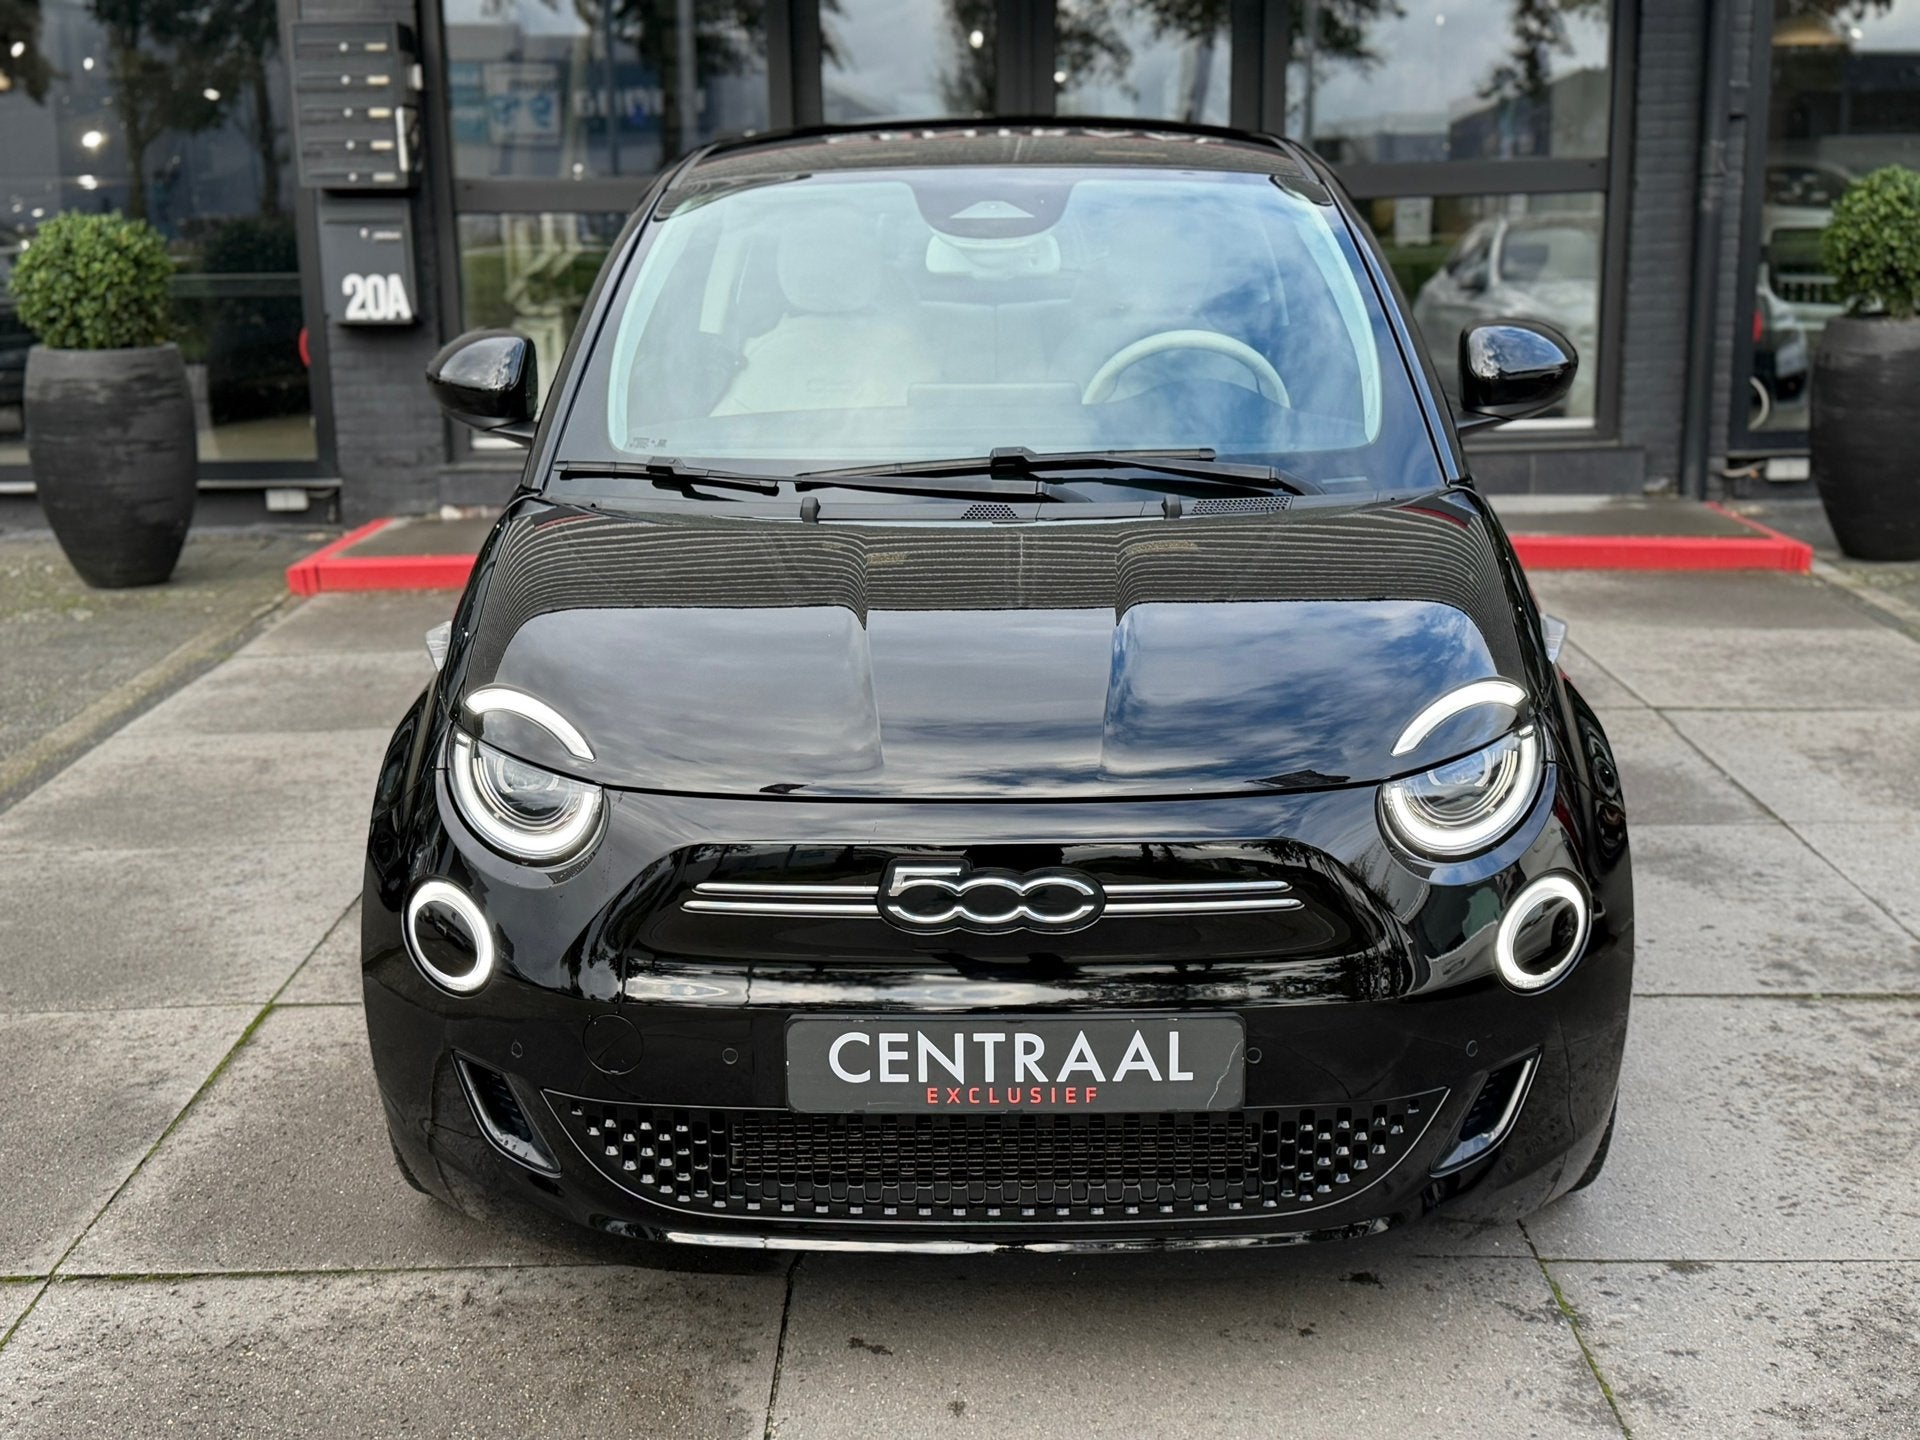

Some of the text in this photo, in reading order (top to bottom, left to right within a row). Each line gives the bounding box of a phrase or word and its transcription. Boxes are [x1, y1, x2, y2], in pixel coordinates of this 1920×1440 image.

[341, 273, 412, 321] 20A
[887, 866, 1097, 925] 500
[828, 1030, 1194, 1084] CENTRAAL
[927, 1086, 1097, 1105] EXCLUSIEF
